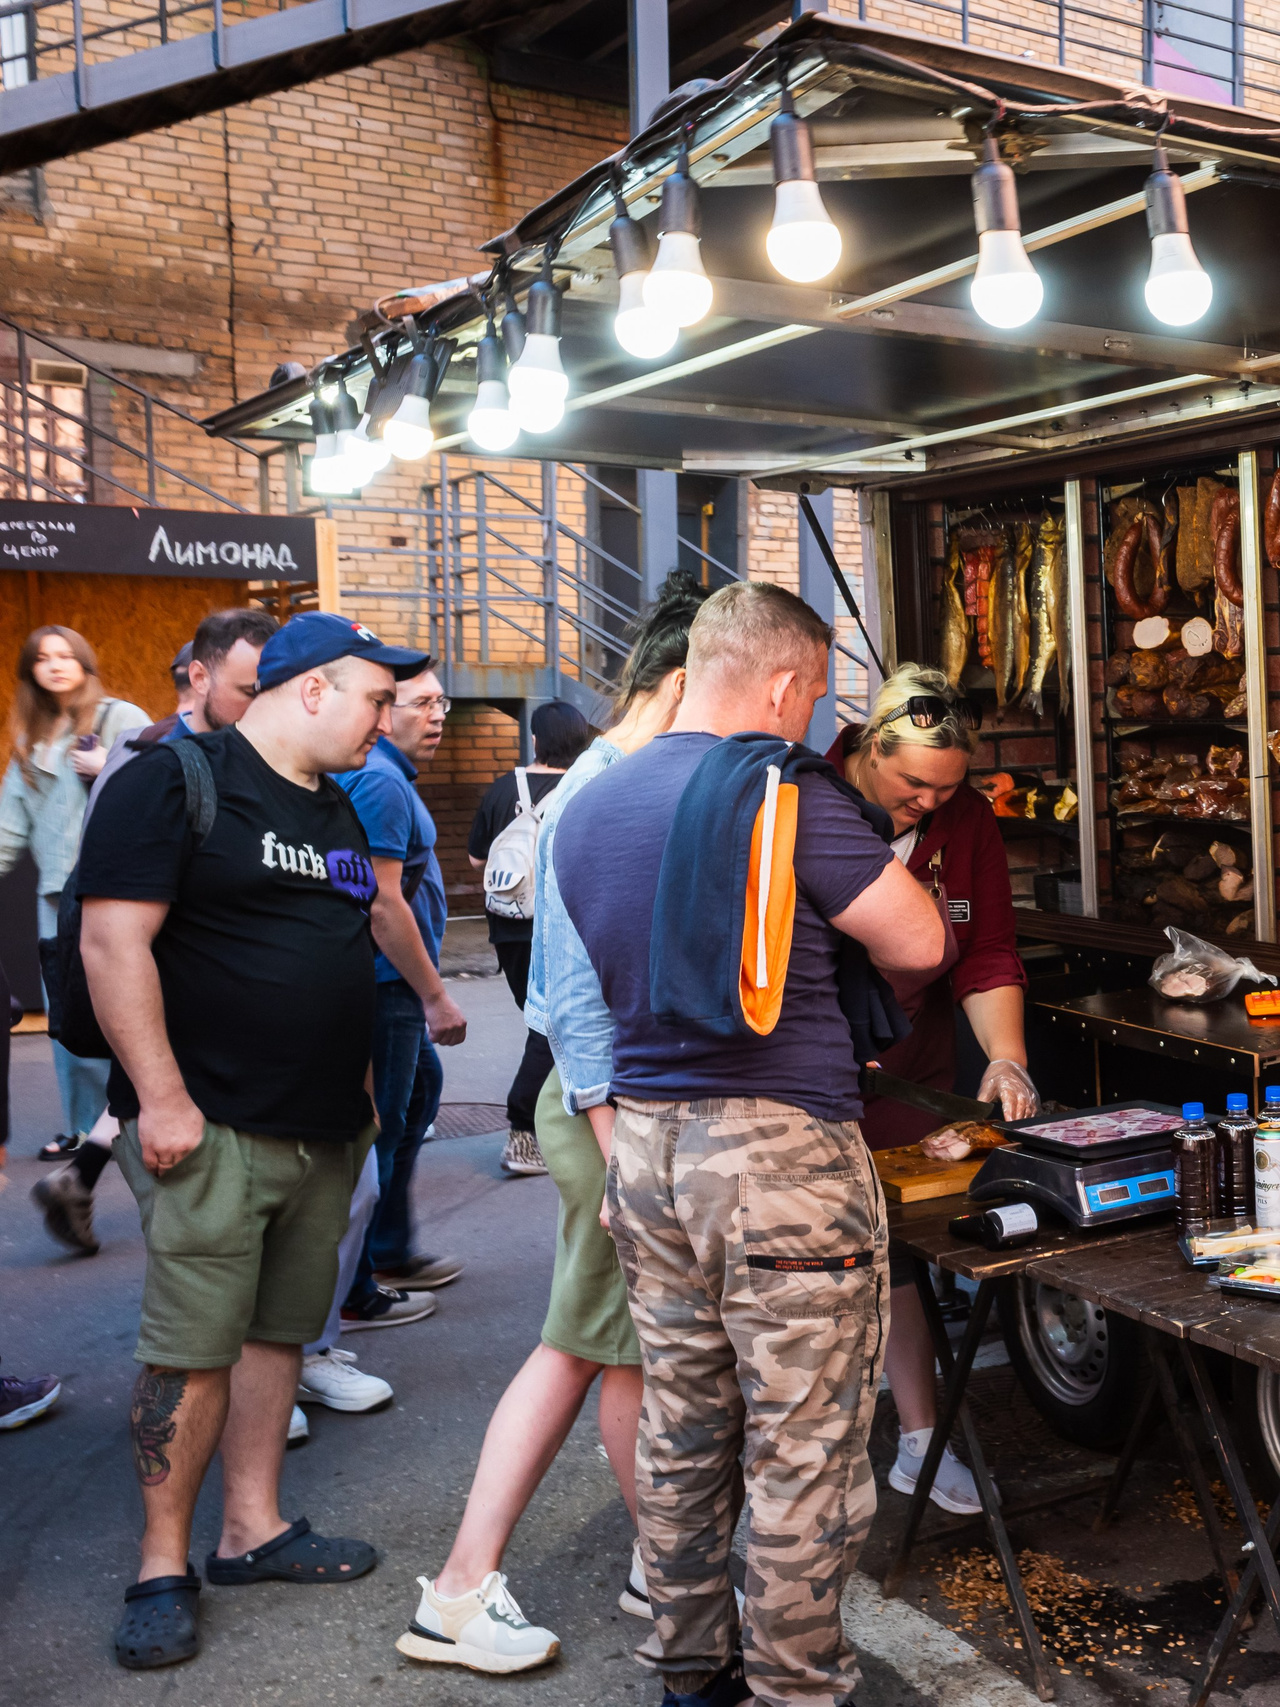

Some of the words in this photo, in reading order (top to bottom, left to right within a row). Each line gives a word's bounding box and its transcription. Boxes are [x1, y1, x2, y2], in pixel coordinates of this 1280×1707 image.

[0, 520, 76, 534] ЕРЕЕХАЛИ
[3, 543, 59, 561] ЦЕНТР
[261, 831, 328, 880] fuck
[336, 853, 369, 887] off
